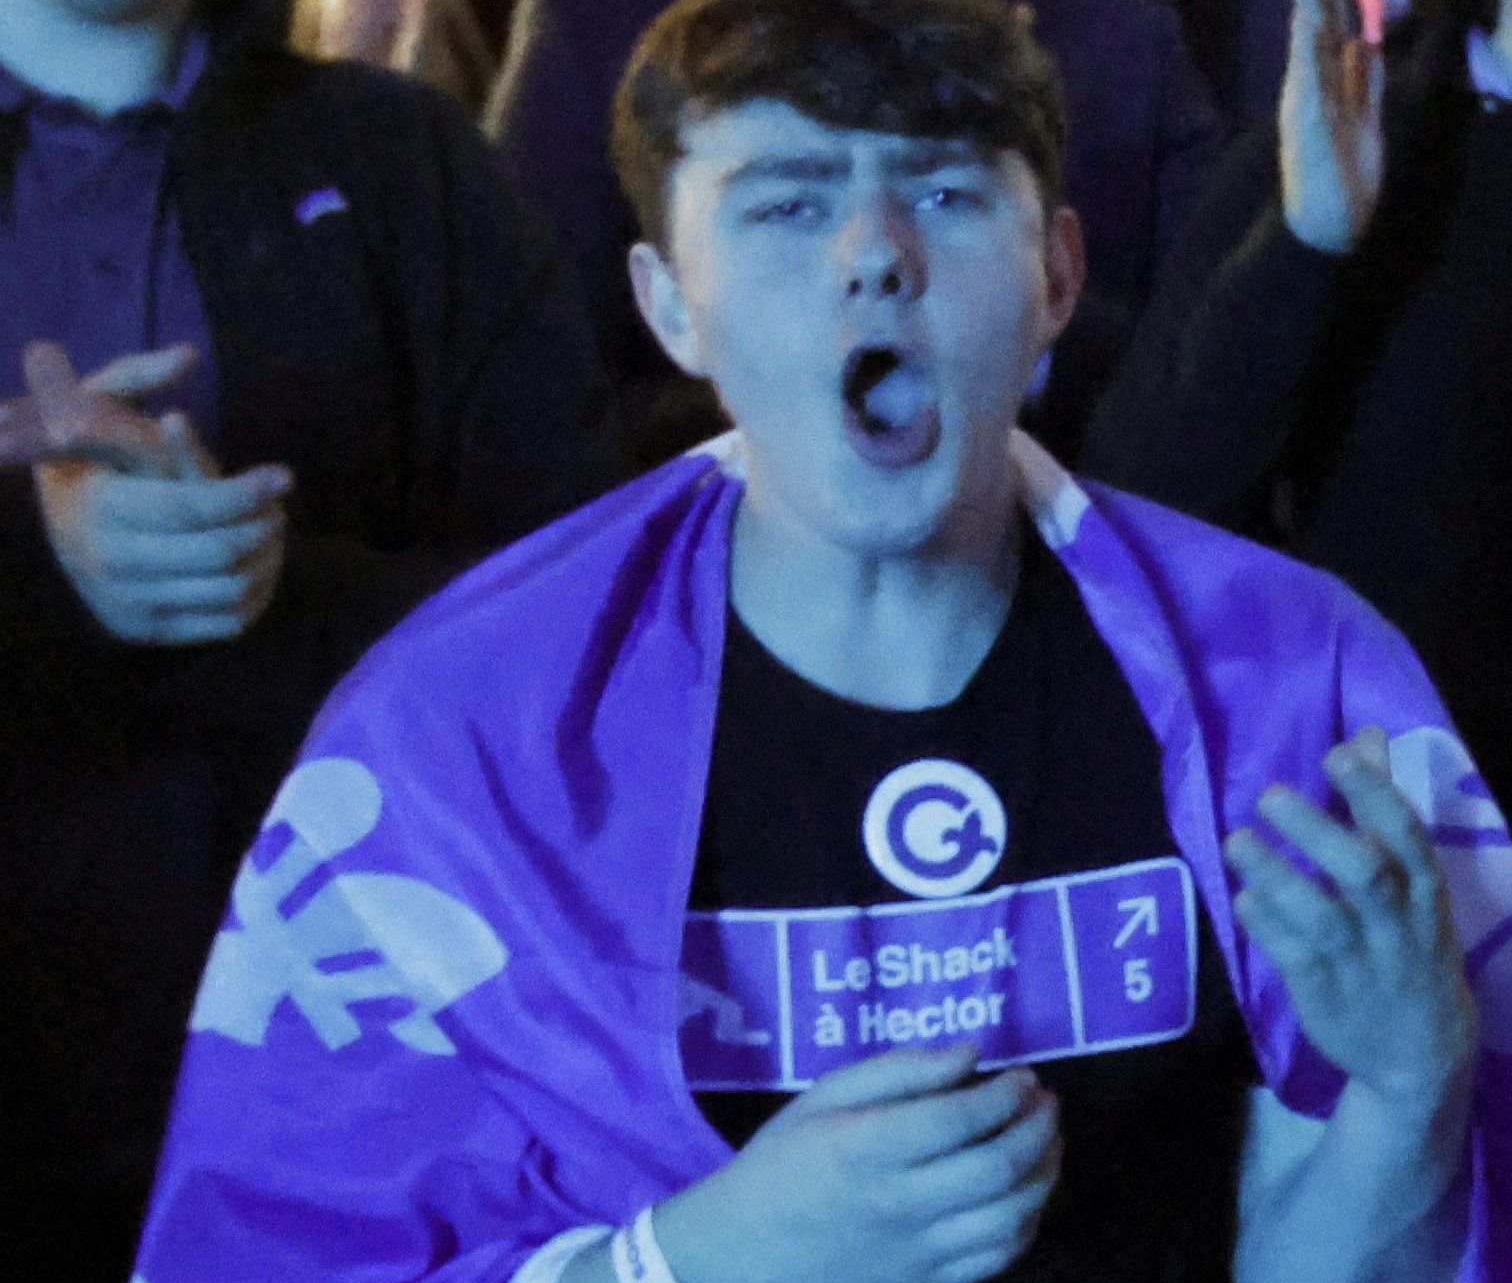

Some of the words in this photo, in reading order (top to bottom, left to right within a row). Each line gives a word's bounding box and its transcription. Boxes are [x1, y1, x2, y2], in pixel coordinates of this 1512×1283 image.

[813, 949, 872, 992] Le
[876, 926, 1016, 989] Shack
[1123, 958, 1153, 1002] 5
[812, 1001, 845, 1047] à
[858, 992, 1006, 1045] Hector
